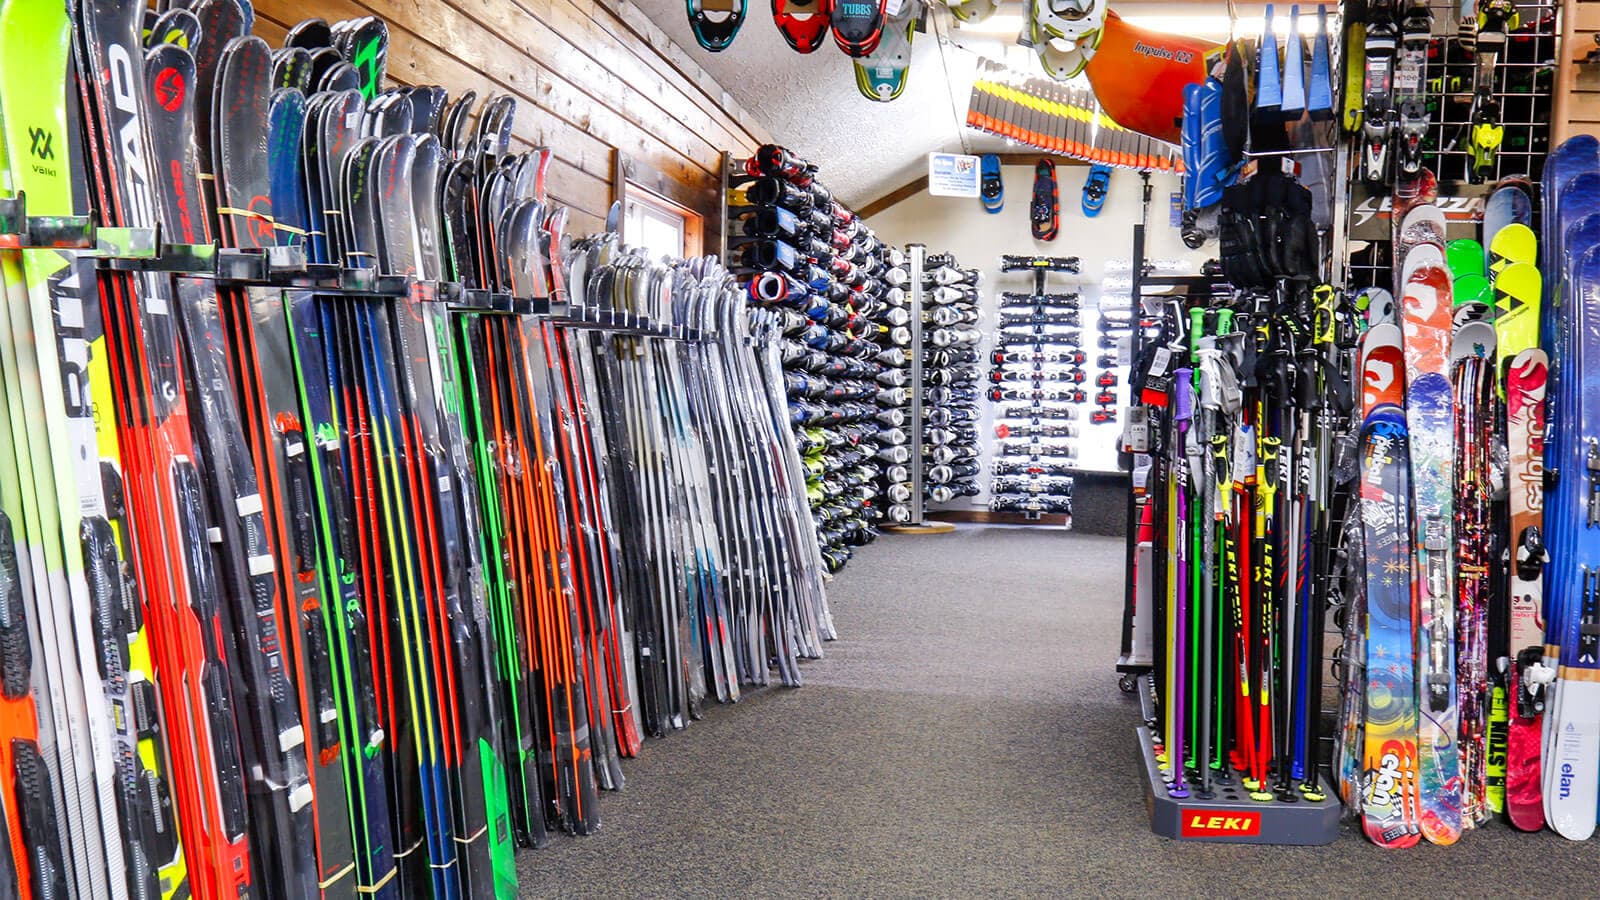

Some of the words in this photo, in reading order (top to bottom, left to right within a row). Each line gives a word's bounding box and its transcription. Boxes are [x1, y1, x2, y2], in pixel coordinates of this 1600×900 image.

[842, 3, 872, 15] TUBBS
[1133, 40, 1174, 60] Impulse
[1279, 445, 1288, 482] LEKI
[1301, 446, 1310, 485] LEKI
[1225, 539, 1237, 582] LEKI
[1264, 543, 1273, 587] LEKI
[1370, 753, 1403, 806] elan
[1559, 763, 1575, 800] elan.
[1190, 815, 1252, 831] LEKI
